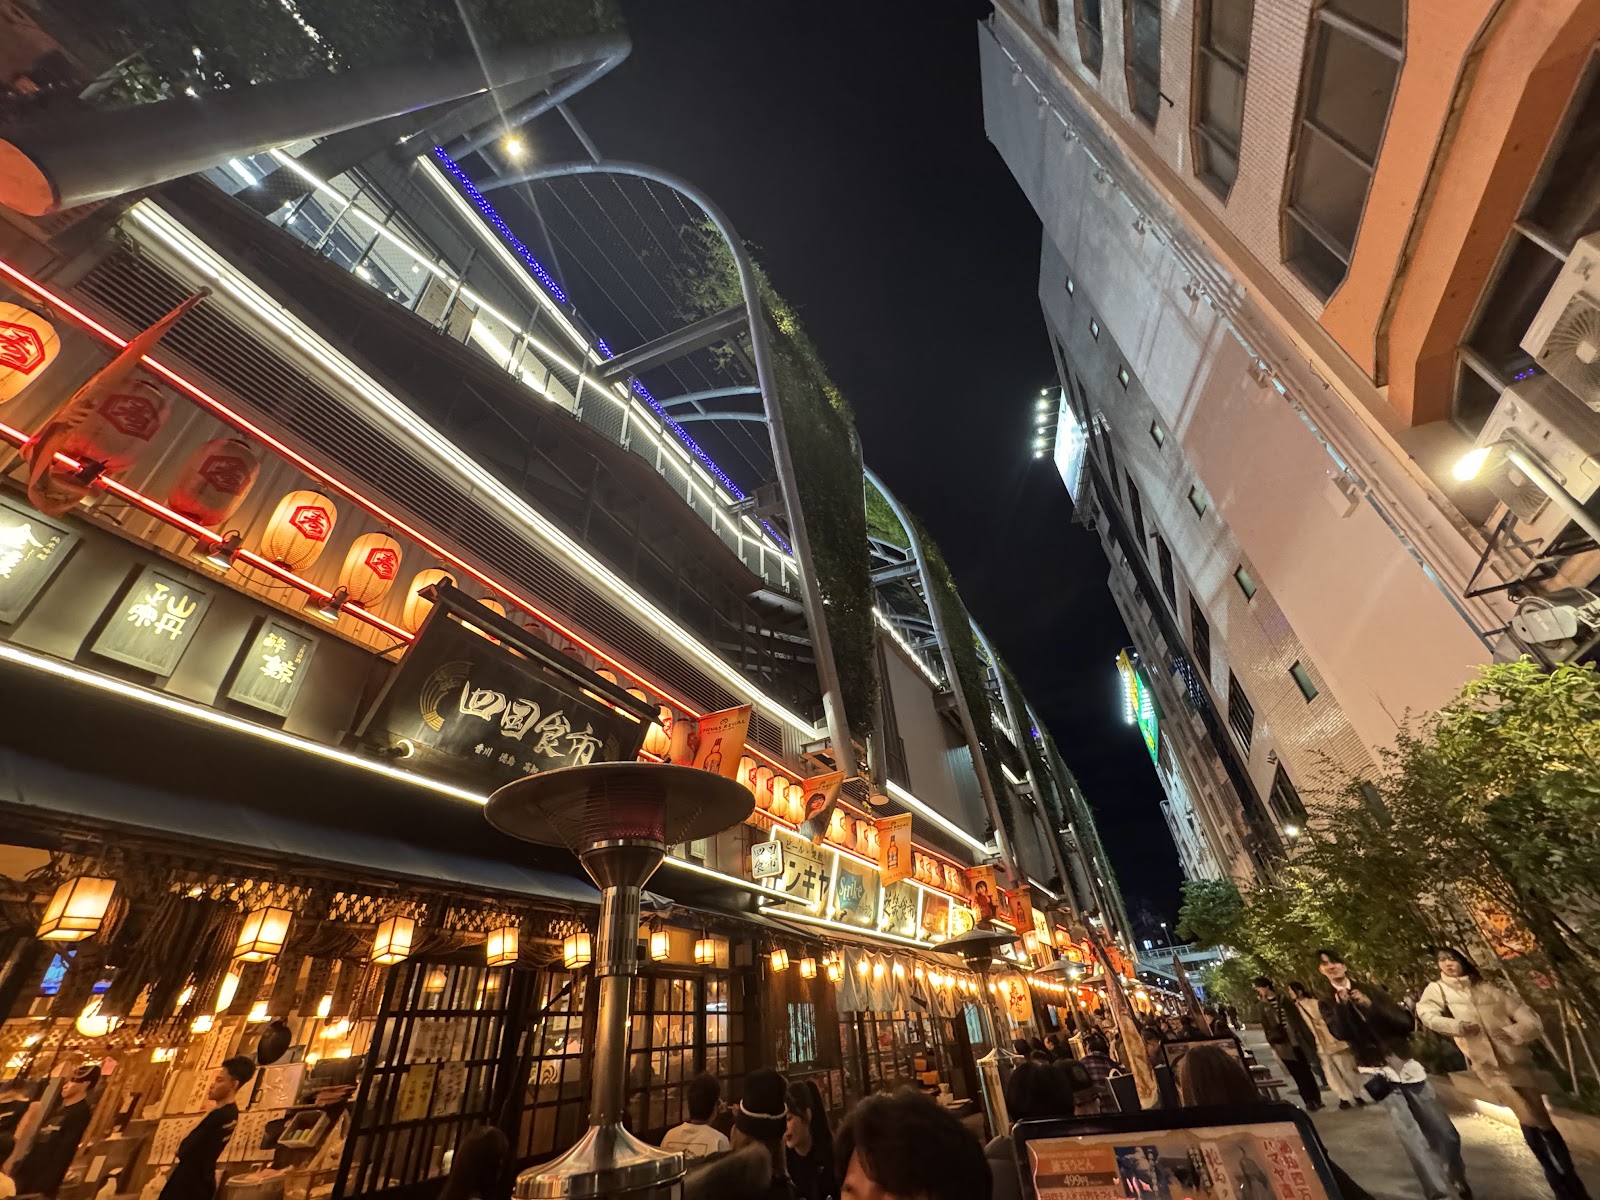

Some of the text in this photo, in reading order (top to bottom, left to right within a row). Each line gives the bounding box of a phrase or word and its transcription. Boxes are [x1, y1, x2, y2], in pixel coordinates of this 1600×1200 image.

[459, 680, 603, 766] 四国食市
[838, 876, 863, 901] Strike
